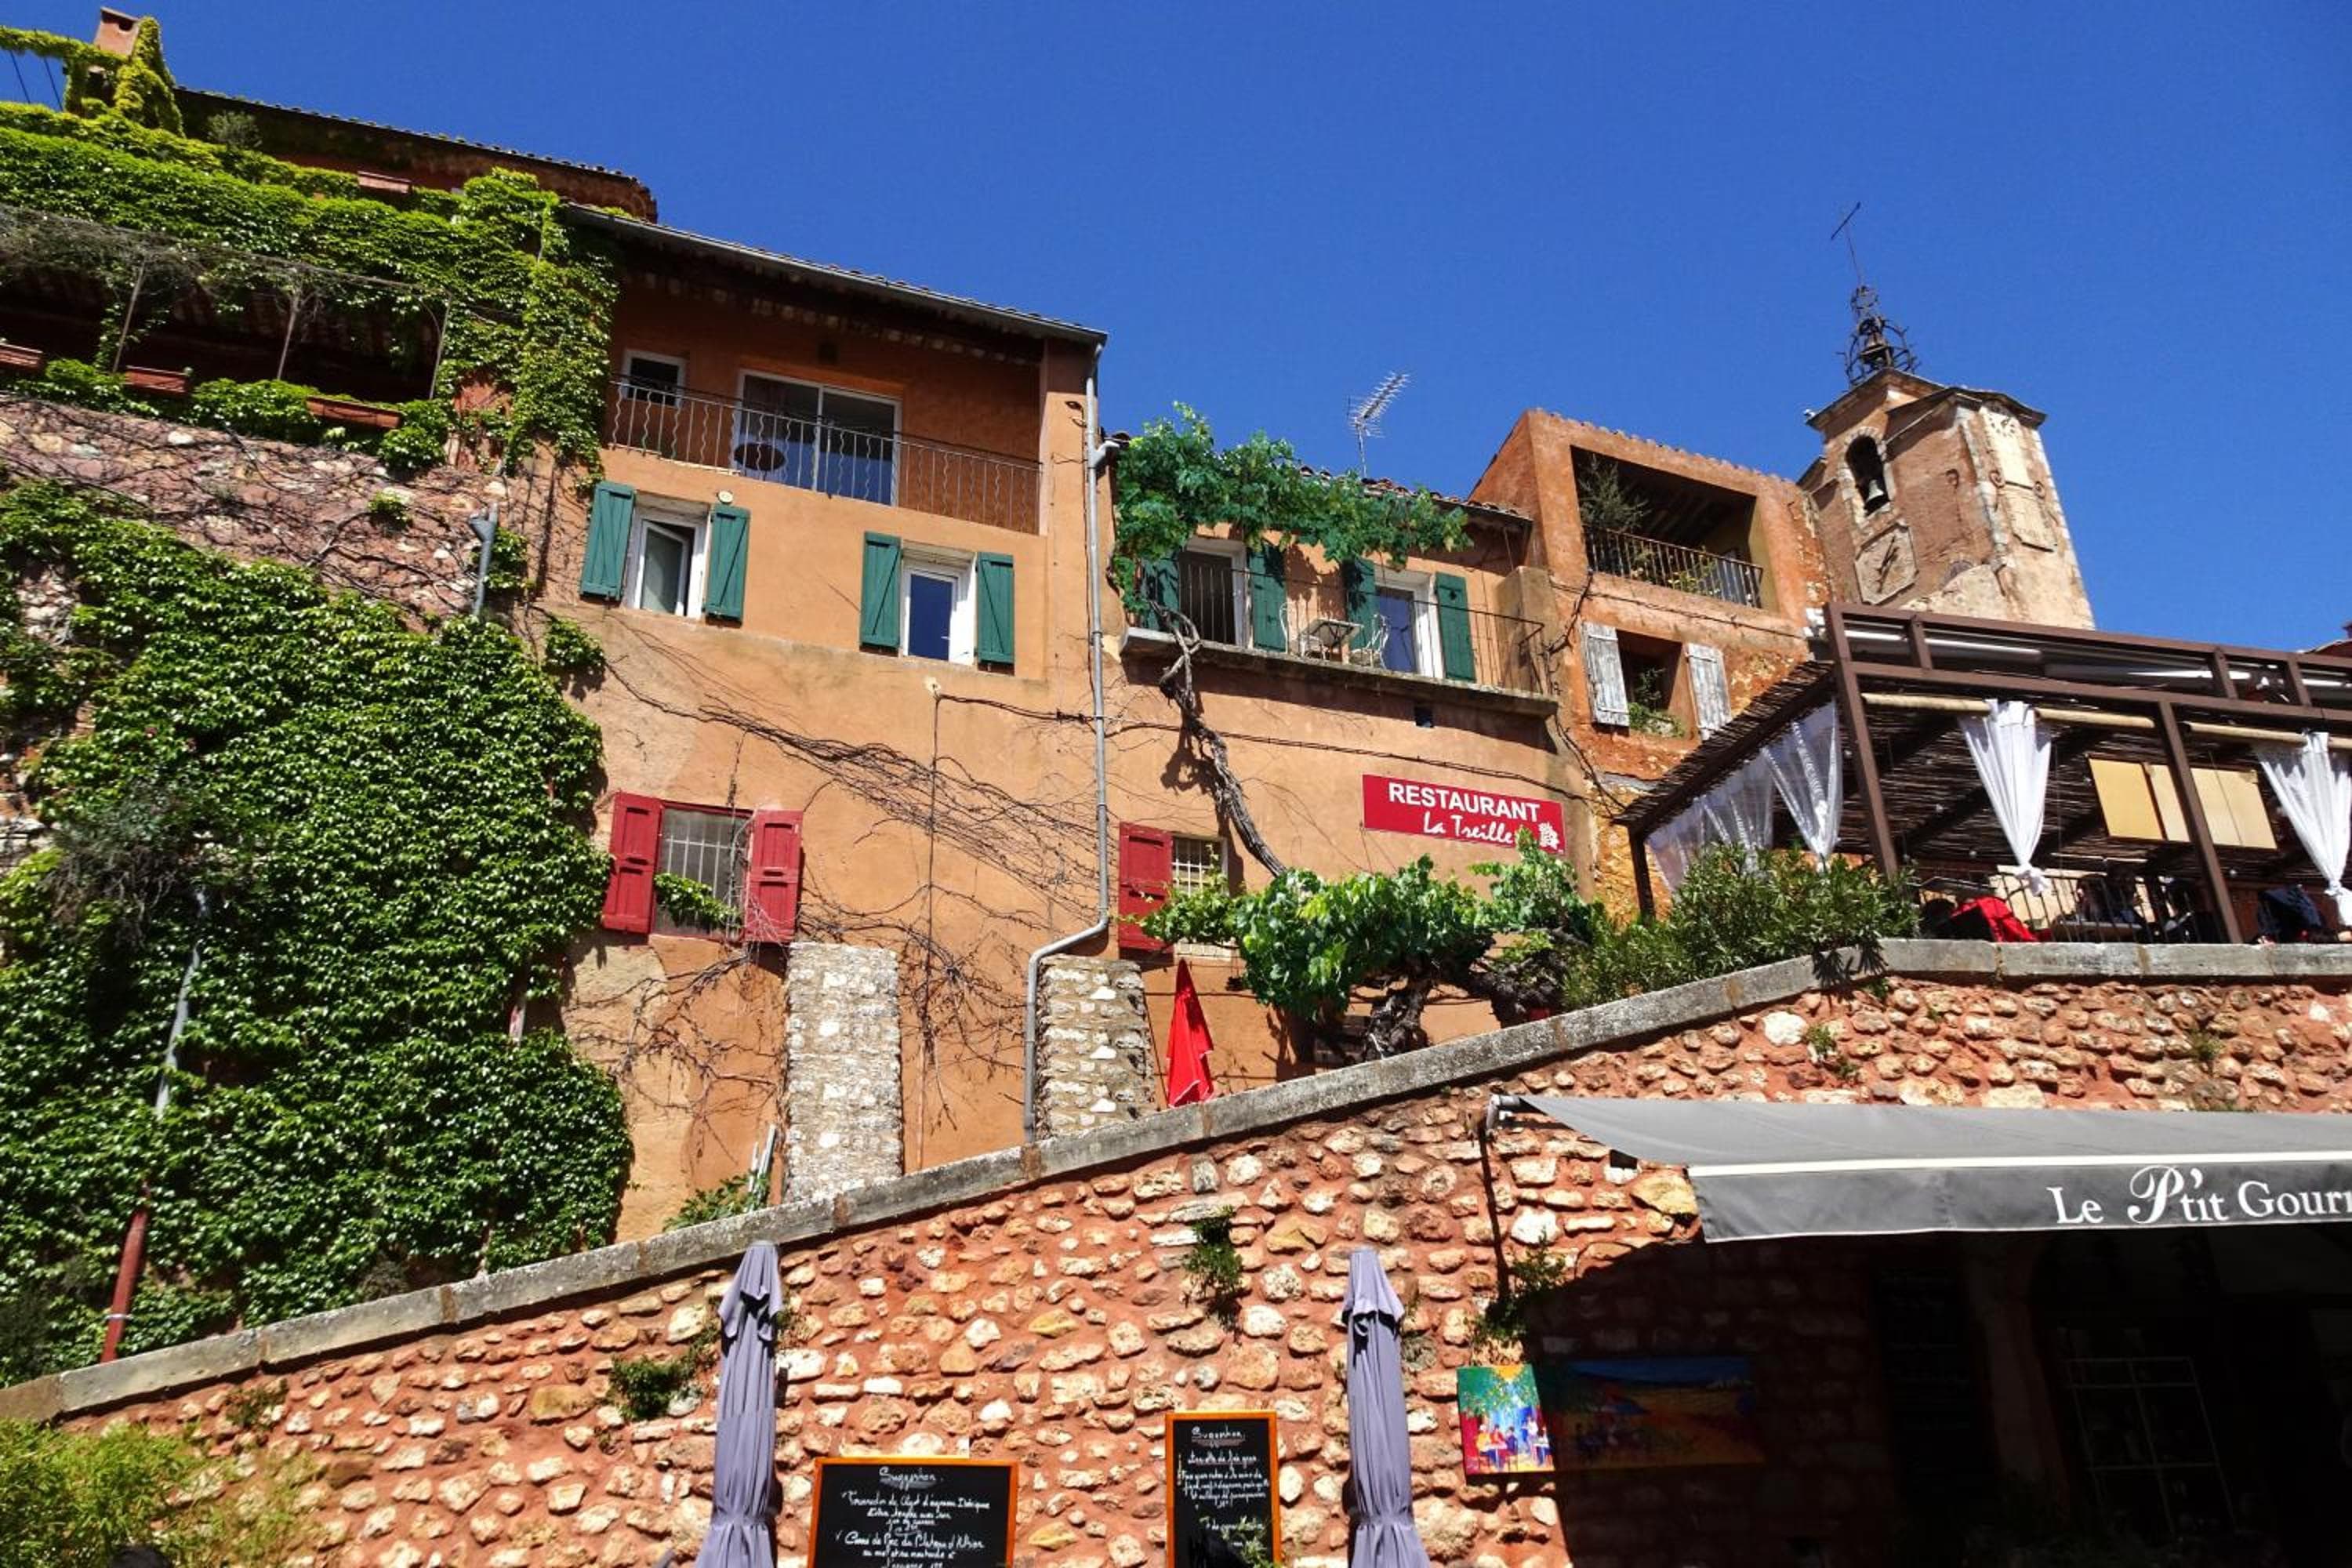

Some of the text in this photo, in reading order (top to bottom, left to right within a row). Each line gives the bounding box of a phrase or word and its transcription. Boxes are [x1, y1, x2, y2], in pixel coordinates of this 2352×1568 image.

[1388, 782, 1541, 823] RESTAURANT
[1423, 811, 1514, 844] La Treille
[2046, 1186, 2105, 1225] Le
[2127, 1165, 2230, 1225] P'tit
